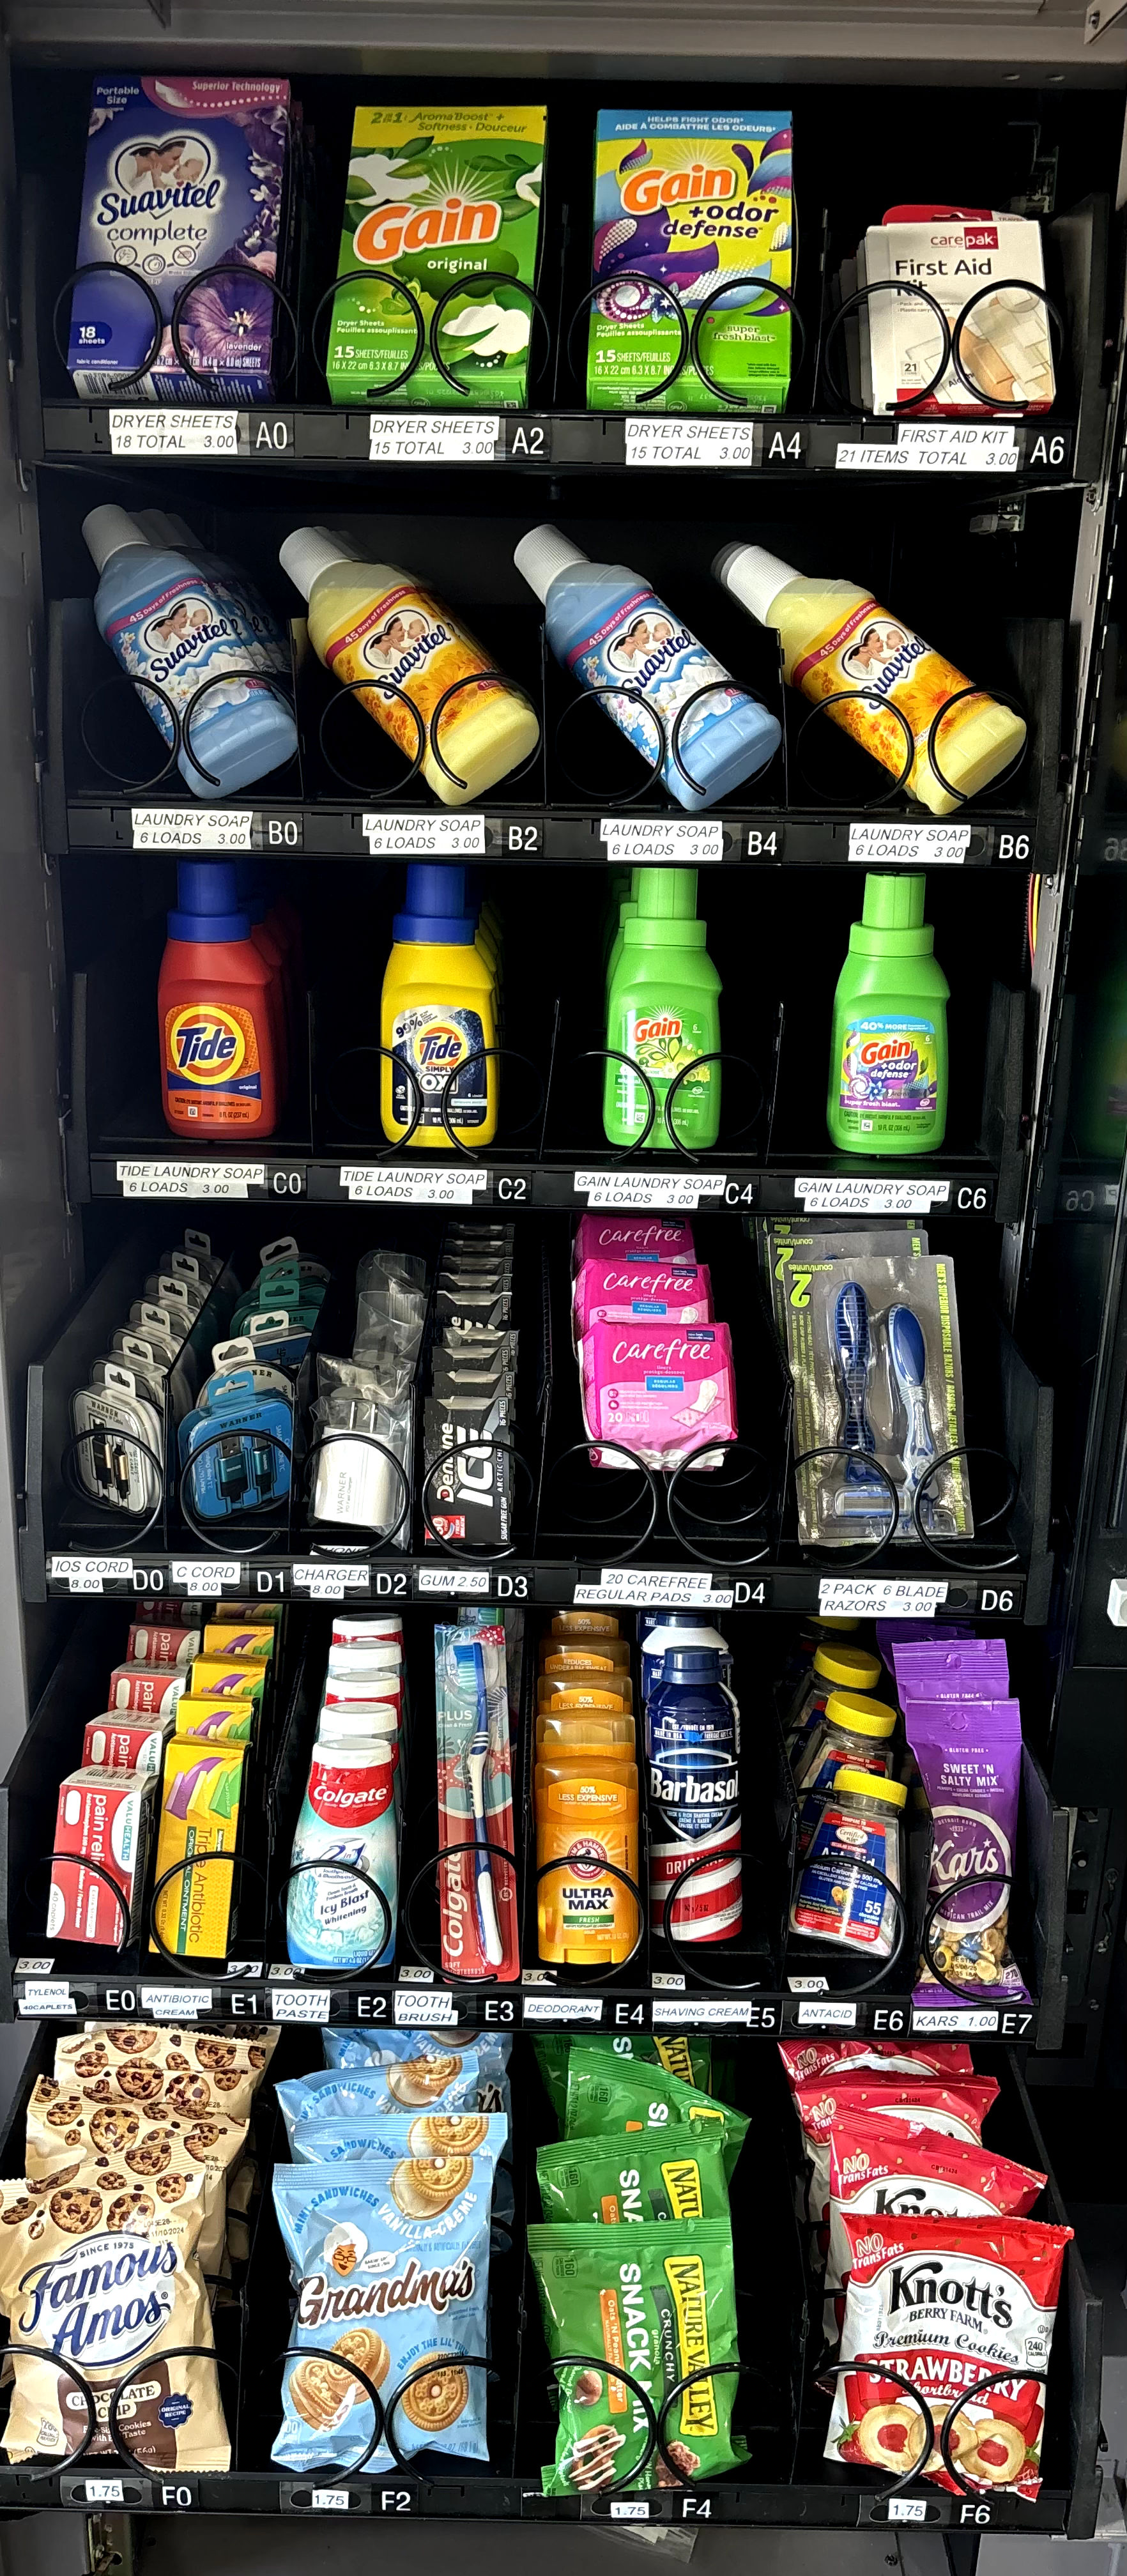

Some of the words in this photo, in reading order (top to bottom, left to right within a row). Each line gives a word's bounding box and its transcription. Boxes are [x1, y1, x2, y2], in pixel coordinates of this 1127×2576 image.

[96, 86, 139, 95] Portable
[192, 81, 229, 91] Superior
[107, 96, 127, 104] Size
[624, 164, 732, 212] Gain
[97, 180, 220, 226] Suavitel
[690, 204, 778, 222] +odor
[107, 220, 207, 250] complete
[356, 198, 500, 261] Gain
[663, 220, 759, 238] defense
[427, 259, 487, 273] original
[895, 259, 947, 276] First
[954, 259, 992, 275] Aid
[79, 327, 95, 338] 18
[226, 342, 261, 351] lavender
[334, 347, 354, 358] 15
[355, 349, 408, 359] SHEETS/FEUILLES
[112, 415, 167, 428] DRYER
[170, 415, 233, 428] SHEETS
[116, 436, 133, 447] 18
[137, 436, 186, 448] TOTAL
[203, 436, 234, 448] 3.00
[256, 422, 288, 449] A0
[512, 427, 544, 454] A2
[769, 432, 801, 459] A4
[901, 430, 947, 442] FIRST
[950, 431, 977, 442] AID
[981, 431, 1008, 443] KIT
[838, 450, 855, 462] 21
[860, 450, 908, 463] ITEMS
[919, 451, 967, 465] TOTAL
[986, 453, 1016, 465] 3.00
[1031, 436, 1064, 464] A6
[588, 633, 602, 646] 45
[601, 620, 616, 635] Days
[615, 613, 622, 623] of
[620, 592, 650, 617] Freshness
[135, 813, 205, 826] LAUNDRY
[208, 815, 249, 827] SOAP
[141, 832, 148, 843] 6
[153, 832, 201, 844] LOADS
[218, 832, 246, 844] 3.00
[269, 820, 298, 845] B0
[509, 826, 537, 850] B2
[748, 831, 777, 855] B4
[999, 834, 1029, 859] B6
[633, 1018, 680, 1042] Gain
[177, 1026, 236, 1070] Tide
[420, 1035, 462, 1065] Tide
[862, 1040, 910, 1064] Gain
[119, 1166, 150, 1177] TIDE
[153, 1167, 221, 1179] LAUNDRY
[223, 1169, 263, 1179] SOAP
[273, 1173, 301, 1195] C0
[498, 1178, 526, 1200] C2
[725, 1183, 753, 1204] C4
[958, 1188, 986, 1209] C6
[937, 1264, 946, 1283] MEN'S
[790, 1274, 812, 1307] 2
[939, 1285, 949, 1314] SUPERIOR
[940, 1315, 952, 1353] DISPOSABLE
[944, 1354, 954, 1378] RAZORS
[220, 1411, 262, 1429] WARNER
[56, 1561, 81, 1572] IOS
[84, 1562, 128, 1573] CORD
[295, 1569, 367, 1581] CHARGER
[134, 1570, 163, 1590] D0
[257, 1572, 285, 1592] D1
[377, 1574, 406, 1594] D2
[420, 1575, 455, 1587] GUM
[457, 1576, 487, 1588] 2.50
[498, 1576, 528, 1597] D3
[606, 1574, 623, 1584] 20
[628, 1575, 708, 1588] CAREFREE
[822, 1583, 830, 1593] 2
[834, 1584, 876, 1595] PACK
[883, 1586, 891, 1595] 6
[896, 1586, 946, 1597] BLADE
[576, 1590, 647, 1602] REGULAR
[651, 1591, 691, 1602] PADS
[703, 1593, 731, 1604] 3.00
[735, 1583, 765, 1604] D4
[981, 1590, 1013, 1611] D6
[824, 1600, 887, 1611] RAZORS
[903, 1602, 931, 1611] 3.00
[944, 1763, 979, 1774] SWEET
[983, 1764, 994, 1774] 'N
[650, 1768, 738, 1803] Barbasol
[941, 1775, 971, 1786] SALTY
[977, 1775, 997, 1786] MIX
[314, 1786, 387, 1807] Colgate
[93, 1794, 108, 1831] pain
[320, 1901, 337, 1914] Icy
[340, 1890, 369, 1908] Blast
[562, 1889, 614, 1900] ULTRA
[569, 1899, 609, 1910] MAX
[180, 1880, 189, 1931] OINTMENT
[189, 1872, 207, 1943] Antibiotic
[325, 1905, 367, 1925] Whitening
[865, 1901, 881, 1915] 55
[106, 1989, 135, 2010] E0
[146, 1995, 210, 2004] ANTIBIOTIC
[232, 1994, 256, 2014] E1
[275, 1995, 327, 2006] TOOTH
[358, 1997, 387, 2017] E2
[528, 2004, 600, 2013] DEODORANT
[276, 2009, 328, 2020] PASTE
[486, 2001, 514, 2021] E3
[616, 2004, 644, 2024] E4
[654, 2007, 706, 2017] SHAVING
[709, 2007, 749, 2017] CREAM
[802, 2009, 852, 2018] ANTACID
[874, 2011, 903, 2030] E6
[916, 2016, 958, 2027] KARS
[968, 2017, 997, 2027] 1.00
[1002, 2013, 1032, 2034] E7
[310, 2186, 379, 2207] SANDWICHES
[80, 2243, 109, 2258] SINCE
[856, 2234, 884, 2257] NO
[19, 2243, 177, 2332] Famous
[298, 2261, 474, 2329] Grandma's
[888, 2261, 1013, 2329] Knott's
[670, 2262, 705, 2348] NATURE
[52, 2290, 171, 2356] Amos
[620, 2263, 651, 2372] SNACK
[908, 2308, 947, 2324] BERRY
[949, 2310, 983, 2333] FARM
[661, 2309, 675, 2382] CRUNCHY
[874, 2331, 951, 2349] Premium
[956, 2335, 1020, 2365] Cookies
[89, 2485, 120, 2497] 1.75
[162, 2486, 192, 2506] F0
[382, 2492, 411, 2511] F2
[683, 2499, 712, 2518] F4
[960, 2504, 991, 2524] F6
